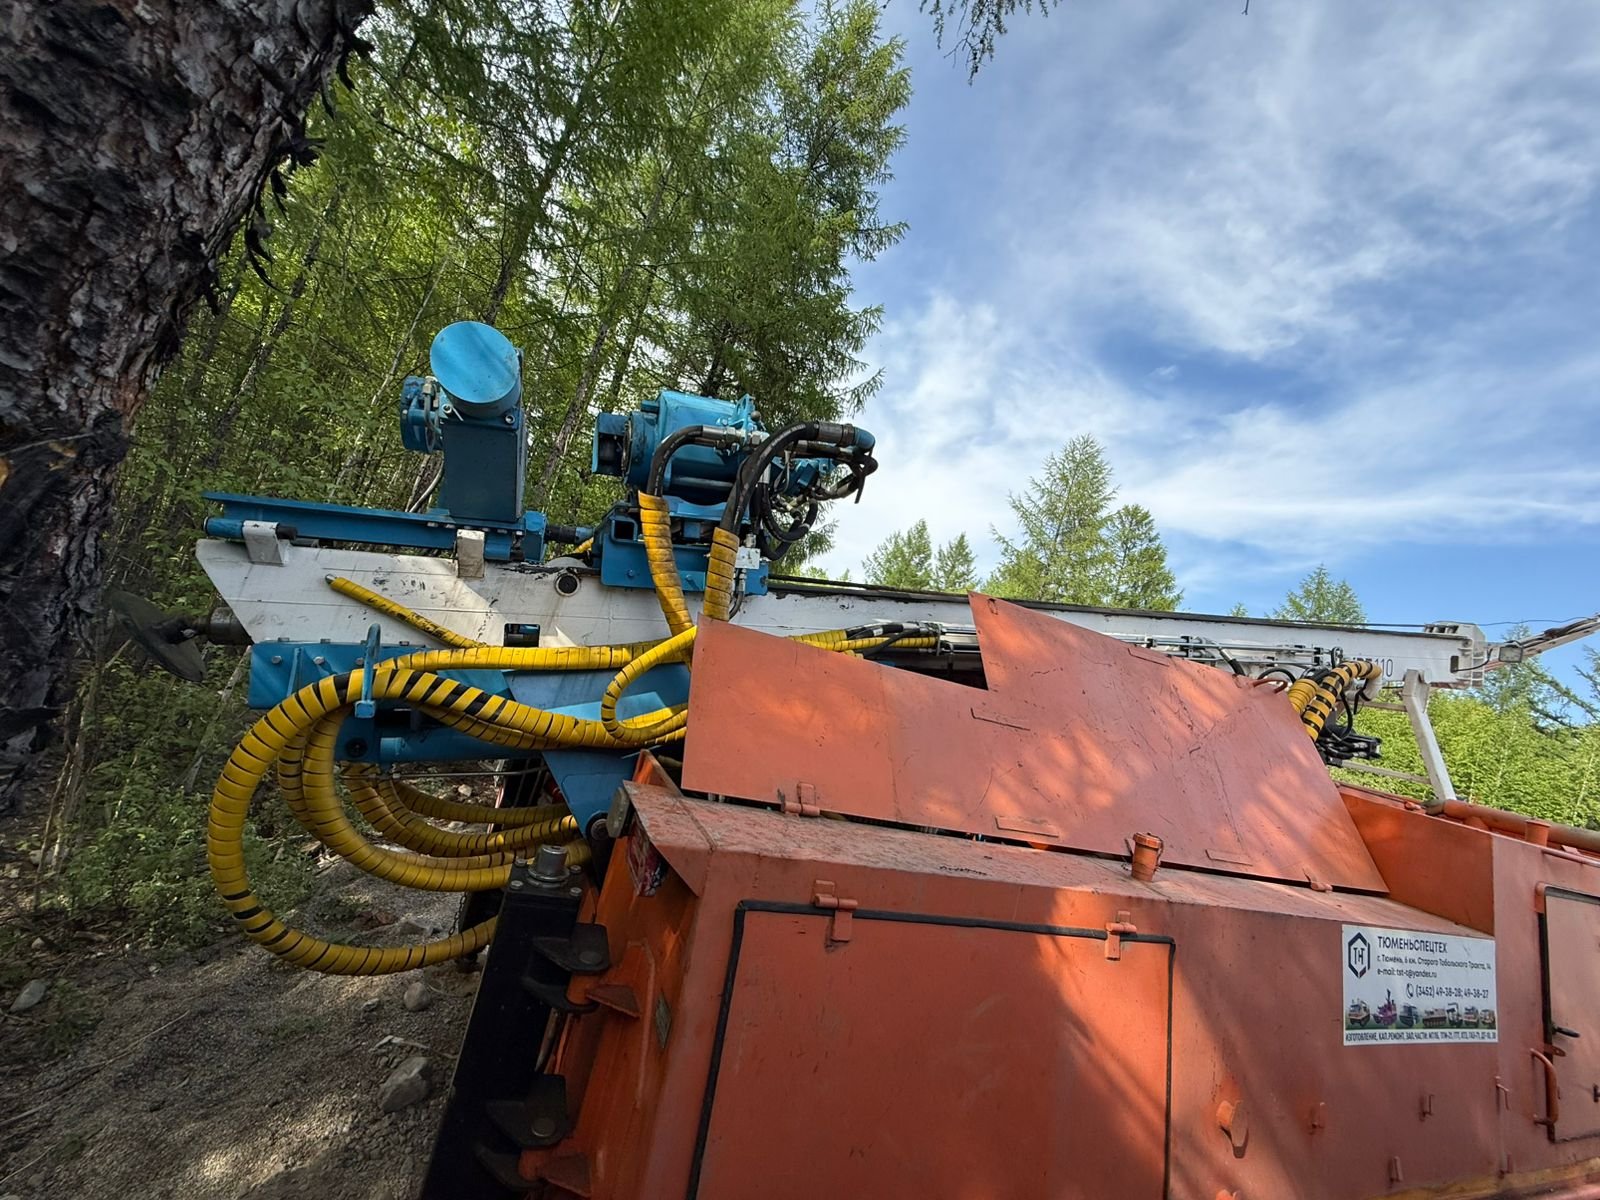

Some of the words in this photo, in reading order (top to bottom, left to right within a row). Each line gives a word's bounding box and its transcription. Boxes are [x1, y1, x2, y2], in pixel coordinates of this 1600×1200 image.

[1377, 936, 1448, 954] ТЮМЕНЬСПЕЦТЕХ
[1415, 984, 1435, 998] (3452)
[1464, 987, 1489, 999] 49-38-27
